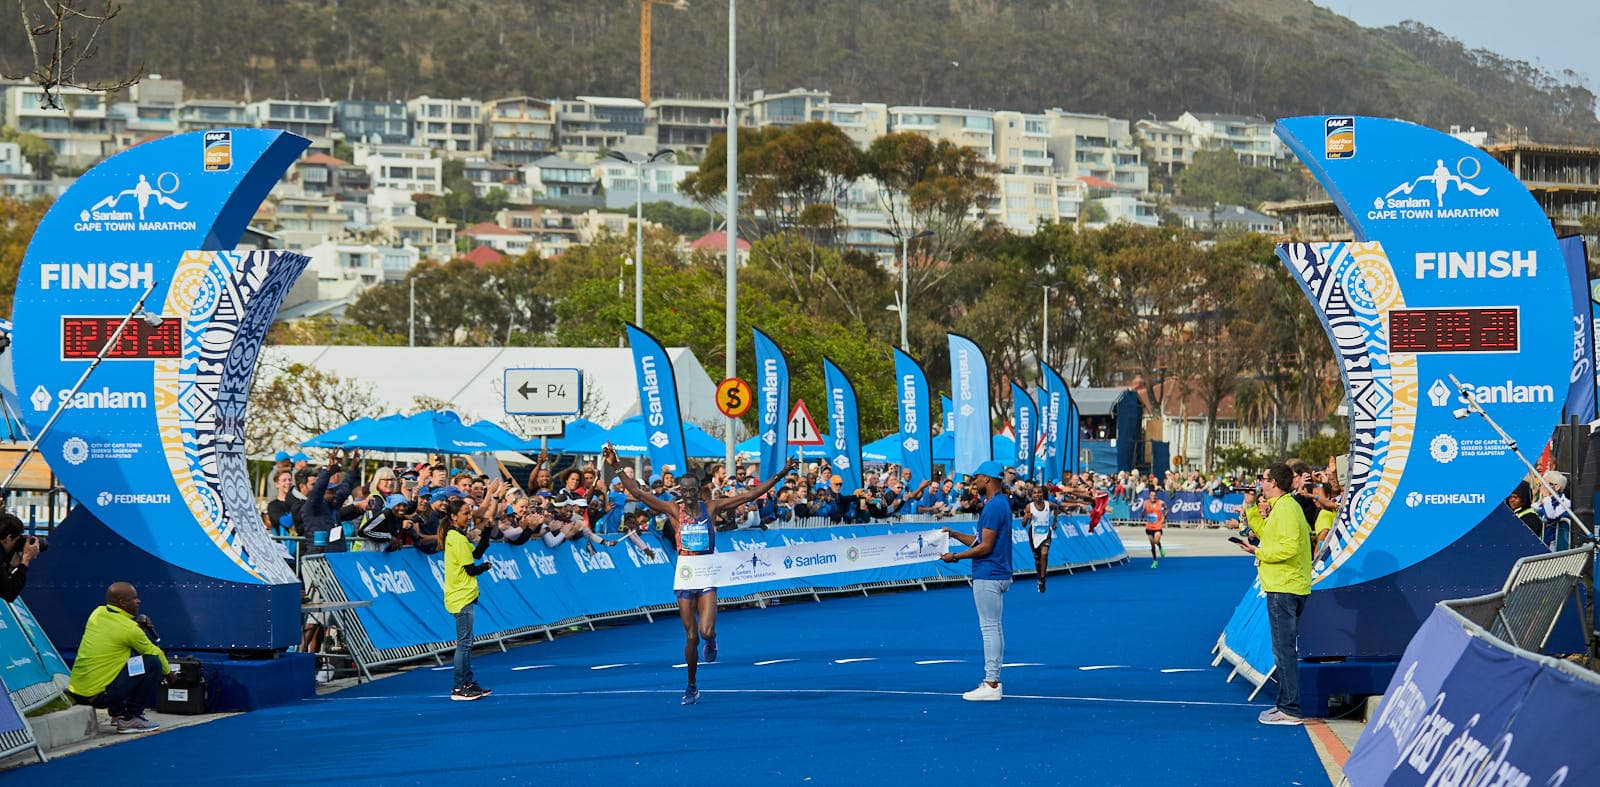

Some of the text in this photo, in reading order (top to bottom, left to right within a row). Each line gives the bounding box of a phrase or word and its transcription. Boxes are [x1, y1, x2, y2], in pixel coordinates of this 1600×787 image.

[1367, 208, 1500, 220] CAPE TOWN MARATHON
[1386, 197, 1430, 208] Sanlam
[74, 221, 197, 232] CAPE TOWN MARATHON
[92, 210, 133, 221] Sanlam
[41, 262, 154, 290] FINISH
[1415, 250, 1538, 280] FINISH
[57, 386, 147, 409] Sanlam
[547, 384, 566, 398] P4
[641, 355, 664, 427] Sanlam
[762, 358, 778, 425] Sanlam
[1457, 380, 1554, 405] Sanlam
[902, 374, 917, 434] Sanlam
[832, 387, 846, 451] Sanlam
[1047, 391, 1060, 443] Sanlam
[1018, 406, 1029, 460] Sanlam
[114, 493, 171, 504] FEDHEALTH
[1181, 499, 1202, 512] asics
[1425, 493, 1486, 505] FEDHEALTH
[795, 552, 838, 568] Sanlam
